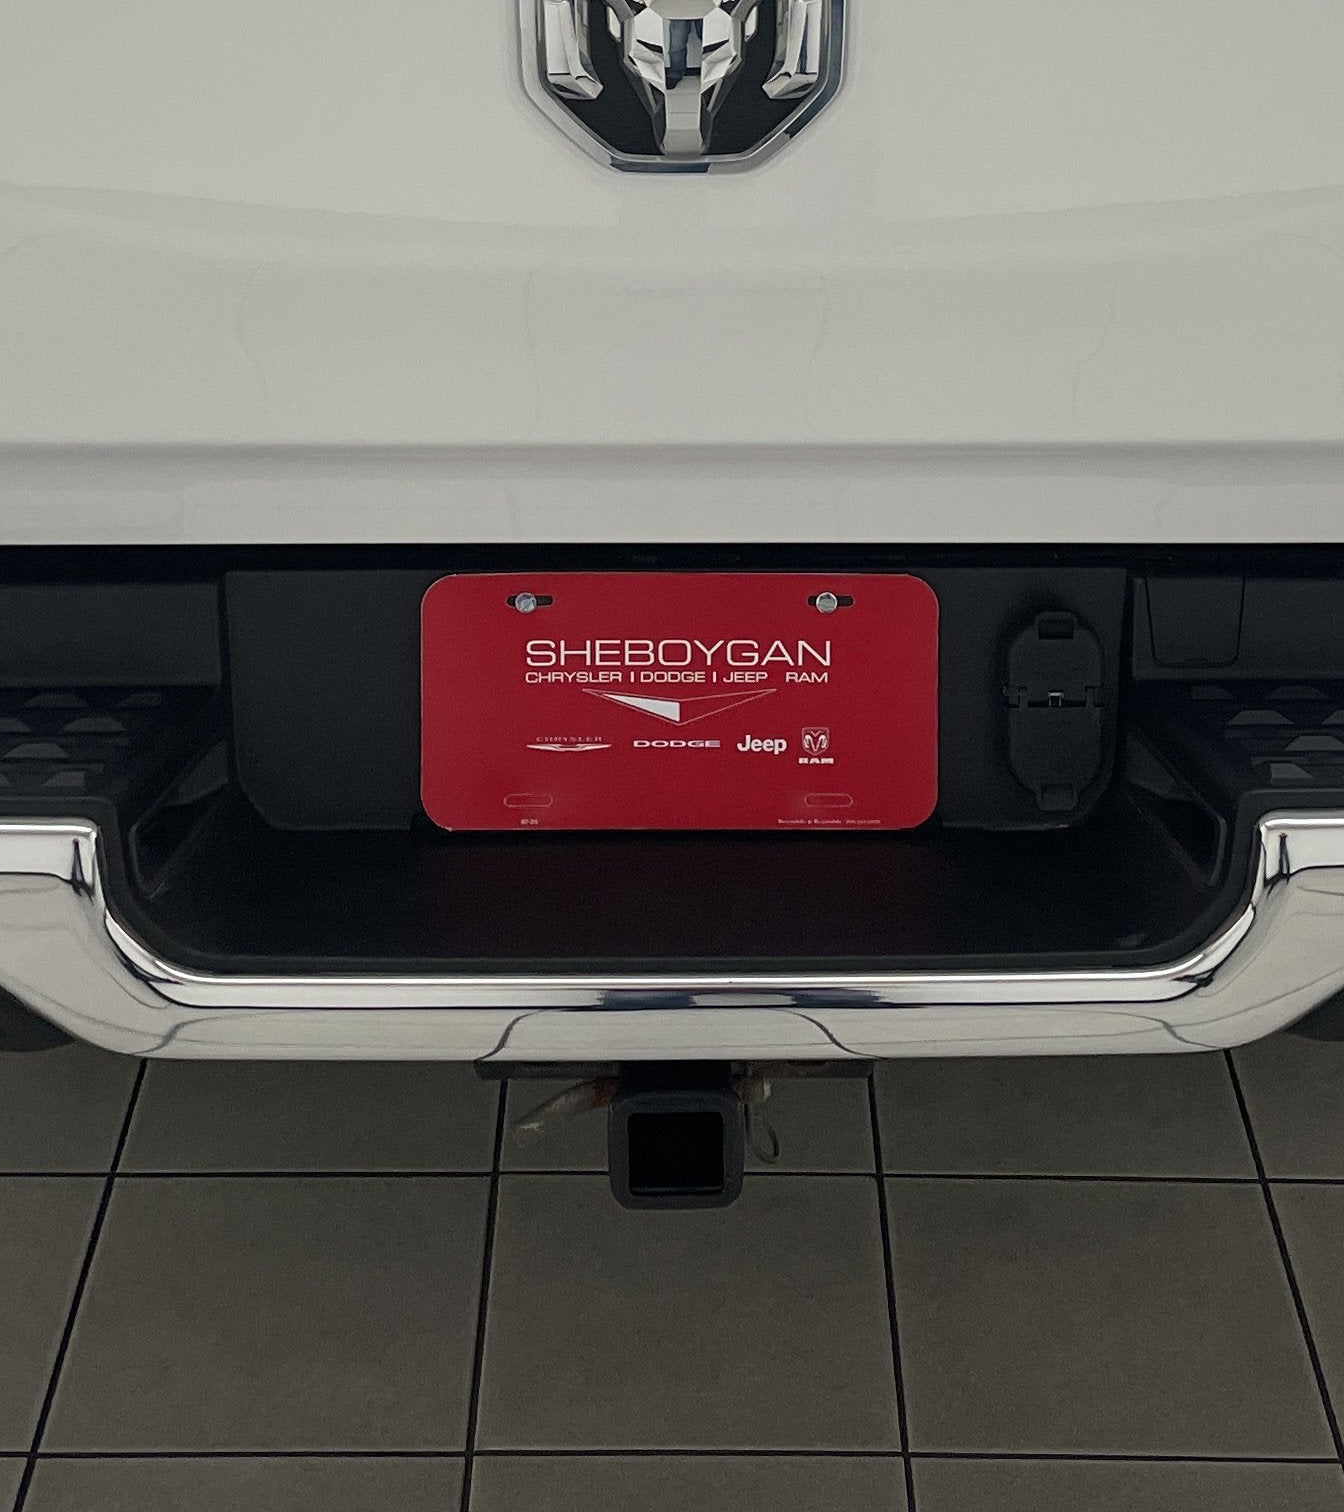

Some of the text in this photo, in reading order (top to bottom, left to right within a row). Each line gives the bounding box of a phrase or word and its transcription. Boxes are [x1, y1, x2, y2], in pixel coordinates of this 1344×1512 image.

[525, 639, 831, 667] SHEBOYGAN
[524, 671, 829, 683] CHRYSLER DODGE JEEP RAM
[632, 739, 721, 748] DODGE
[737, 734, 787, 755] Jeep
